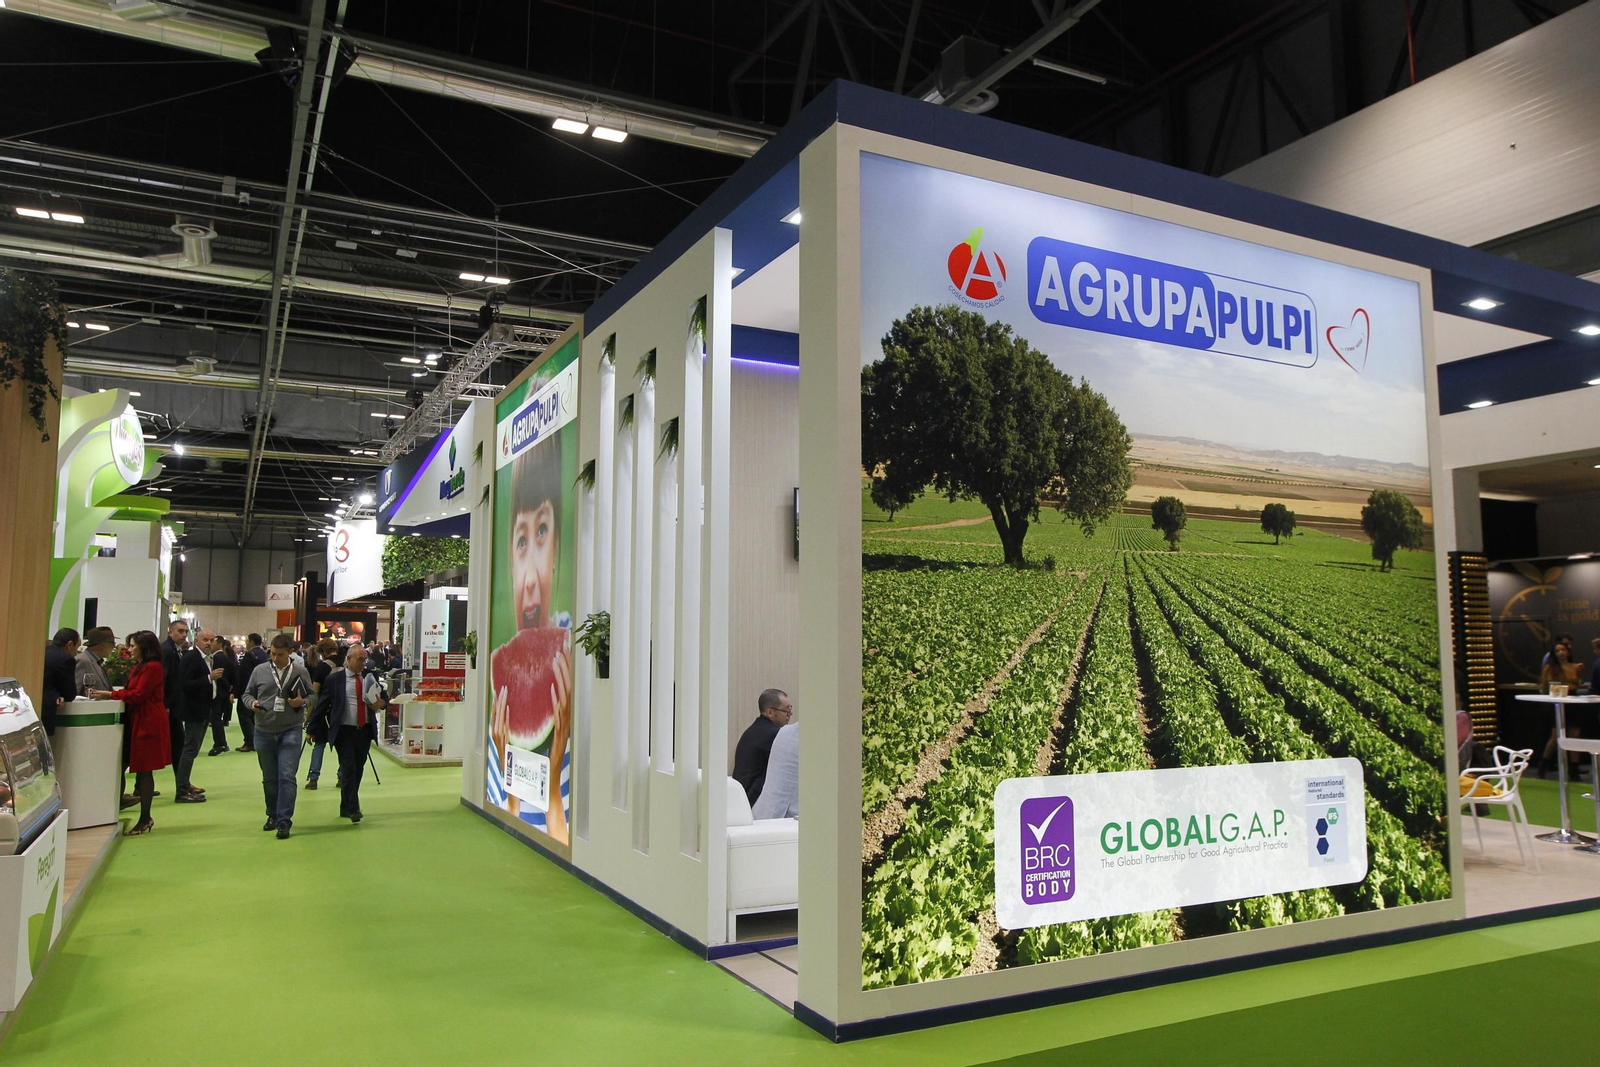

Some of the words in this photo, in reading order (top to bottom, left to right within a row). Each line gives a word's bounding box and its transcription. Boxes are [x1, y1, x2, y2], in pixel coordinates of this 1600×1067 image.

[948, 285, 985, 309] COSECHAMOS
[984, 295, 1006, 309] CALIDAD
[1035, 255, 1313, 354] AGRUPAPULPI
[512, 391, 559, 449] AGRUPAPULPI
[1558, 599, 1590, 609] Time
[1307, 778, 1344, 788] international
[1316, 791, 1345, 800] standards
[1327, 812, 1338, 820] IFS
[1025, 844, 1070, 870] BRC
[1101, 858, 1115, 869] The
[1117, 855, 1143, 867] Global
[1145, 850, 1186, 864] Partnership
[1188, 848, 1198, 859] for
[1200, 846, 1221, 858] Good
[1222, 841, 1262, 858] Agricultural
[1263, 840, 1289, 850] Practice
[1025, 870, 1071, 882] CERTIFICATION
[1025, 879, 1071, 898] BODY
